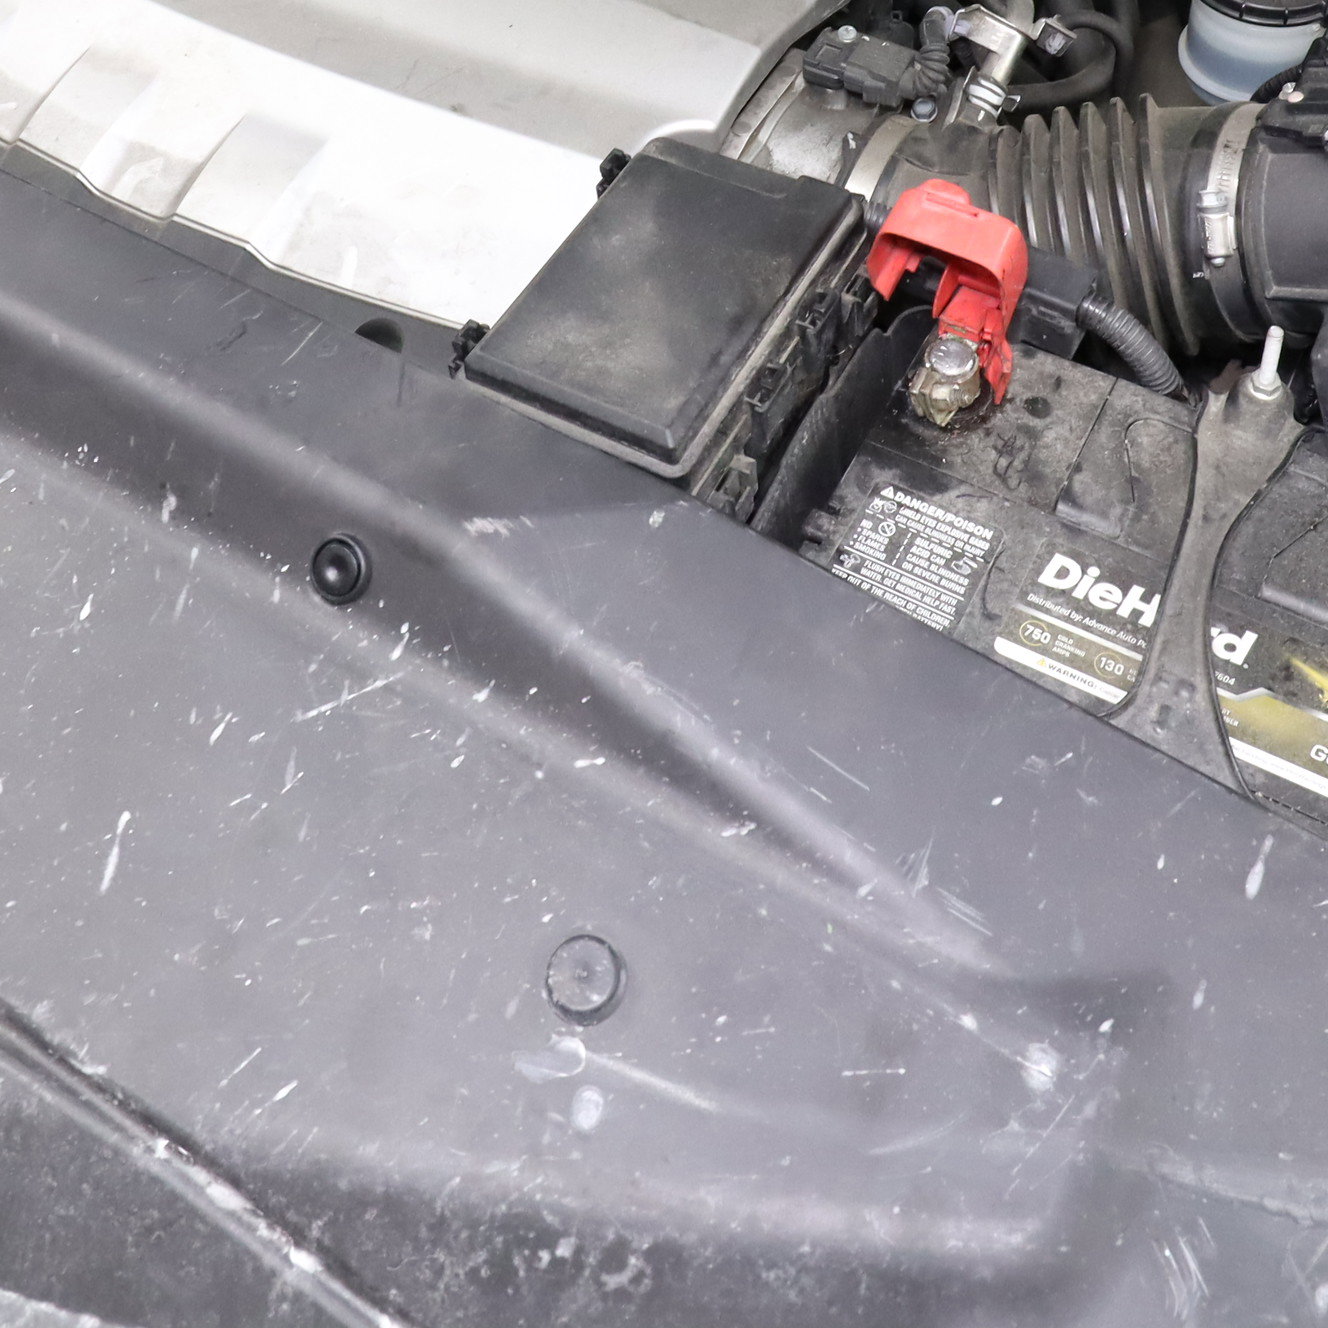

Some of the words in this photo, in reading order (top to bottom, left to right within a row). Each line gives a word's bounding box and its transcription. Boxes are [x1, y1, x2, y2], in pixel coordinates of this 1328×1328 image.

[860, 519, 873, 529] NO
[893, 491, 994, 540] DANGER/POISON
[861, 528, 889, 544] SPARKS
[895, 514, 907, 523] CAN
[906, 519, 925, 531] CAUSE
[924, 527, 955, 544] BLINDNESS
[954, 540, 964, 548] OR
[920, 515, 937, 527] EYES
[936, 522, 969, 541] EXPLOSIVE
[969, 536, 990, 550] GASES
[853, 542, 886, 560] SMOKING
[857, 535, 885, 551] FLAMES
[914, 537, 953, 558] SULFURIC
[910, 545, 930, 559] ACID
[930, 554, 946, 565] CAN
[901, 561, 913, 571] OR
[913, 566, 940, 583] SEVERE
[940, 578, 966, 594] BURNS
[906, 554, 929, 569] CAUSE
[929, 564, 969, 586] BLINDNESS
[864, 560, 884, 573] FLUSH
[884, 569, 900, 580] EYES
[900, 575, 940, 598] IMMEDIATELY
[939, 593, 957, 605] WITH
[883, 577, 896, 588] GET
[895, 583, 923, 599] MEDICAL
[922, 595, 939, 607] HELP
[861, 582, 870, 590] OF
[870, 586, 884, 596] THE
[883, 592, 906, 606] REACH
[906, 602, 916, 611] OF
[1027, 593, 1071, 616] Distributed
[1069, 610, 1083, 622] by:
[1082, 616, 1117, 636] Advance
[1116, 630, 1137, 644] Auto
[1023, 624, 1051, 644] 750
[1052, 646, 1070, 657] AMPS
[1054, 640, 1085, 657] CRANKING
[1098, 657, 1125, 676] 130
